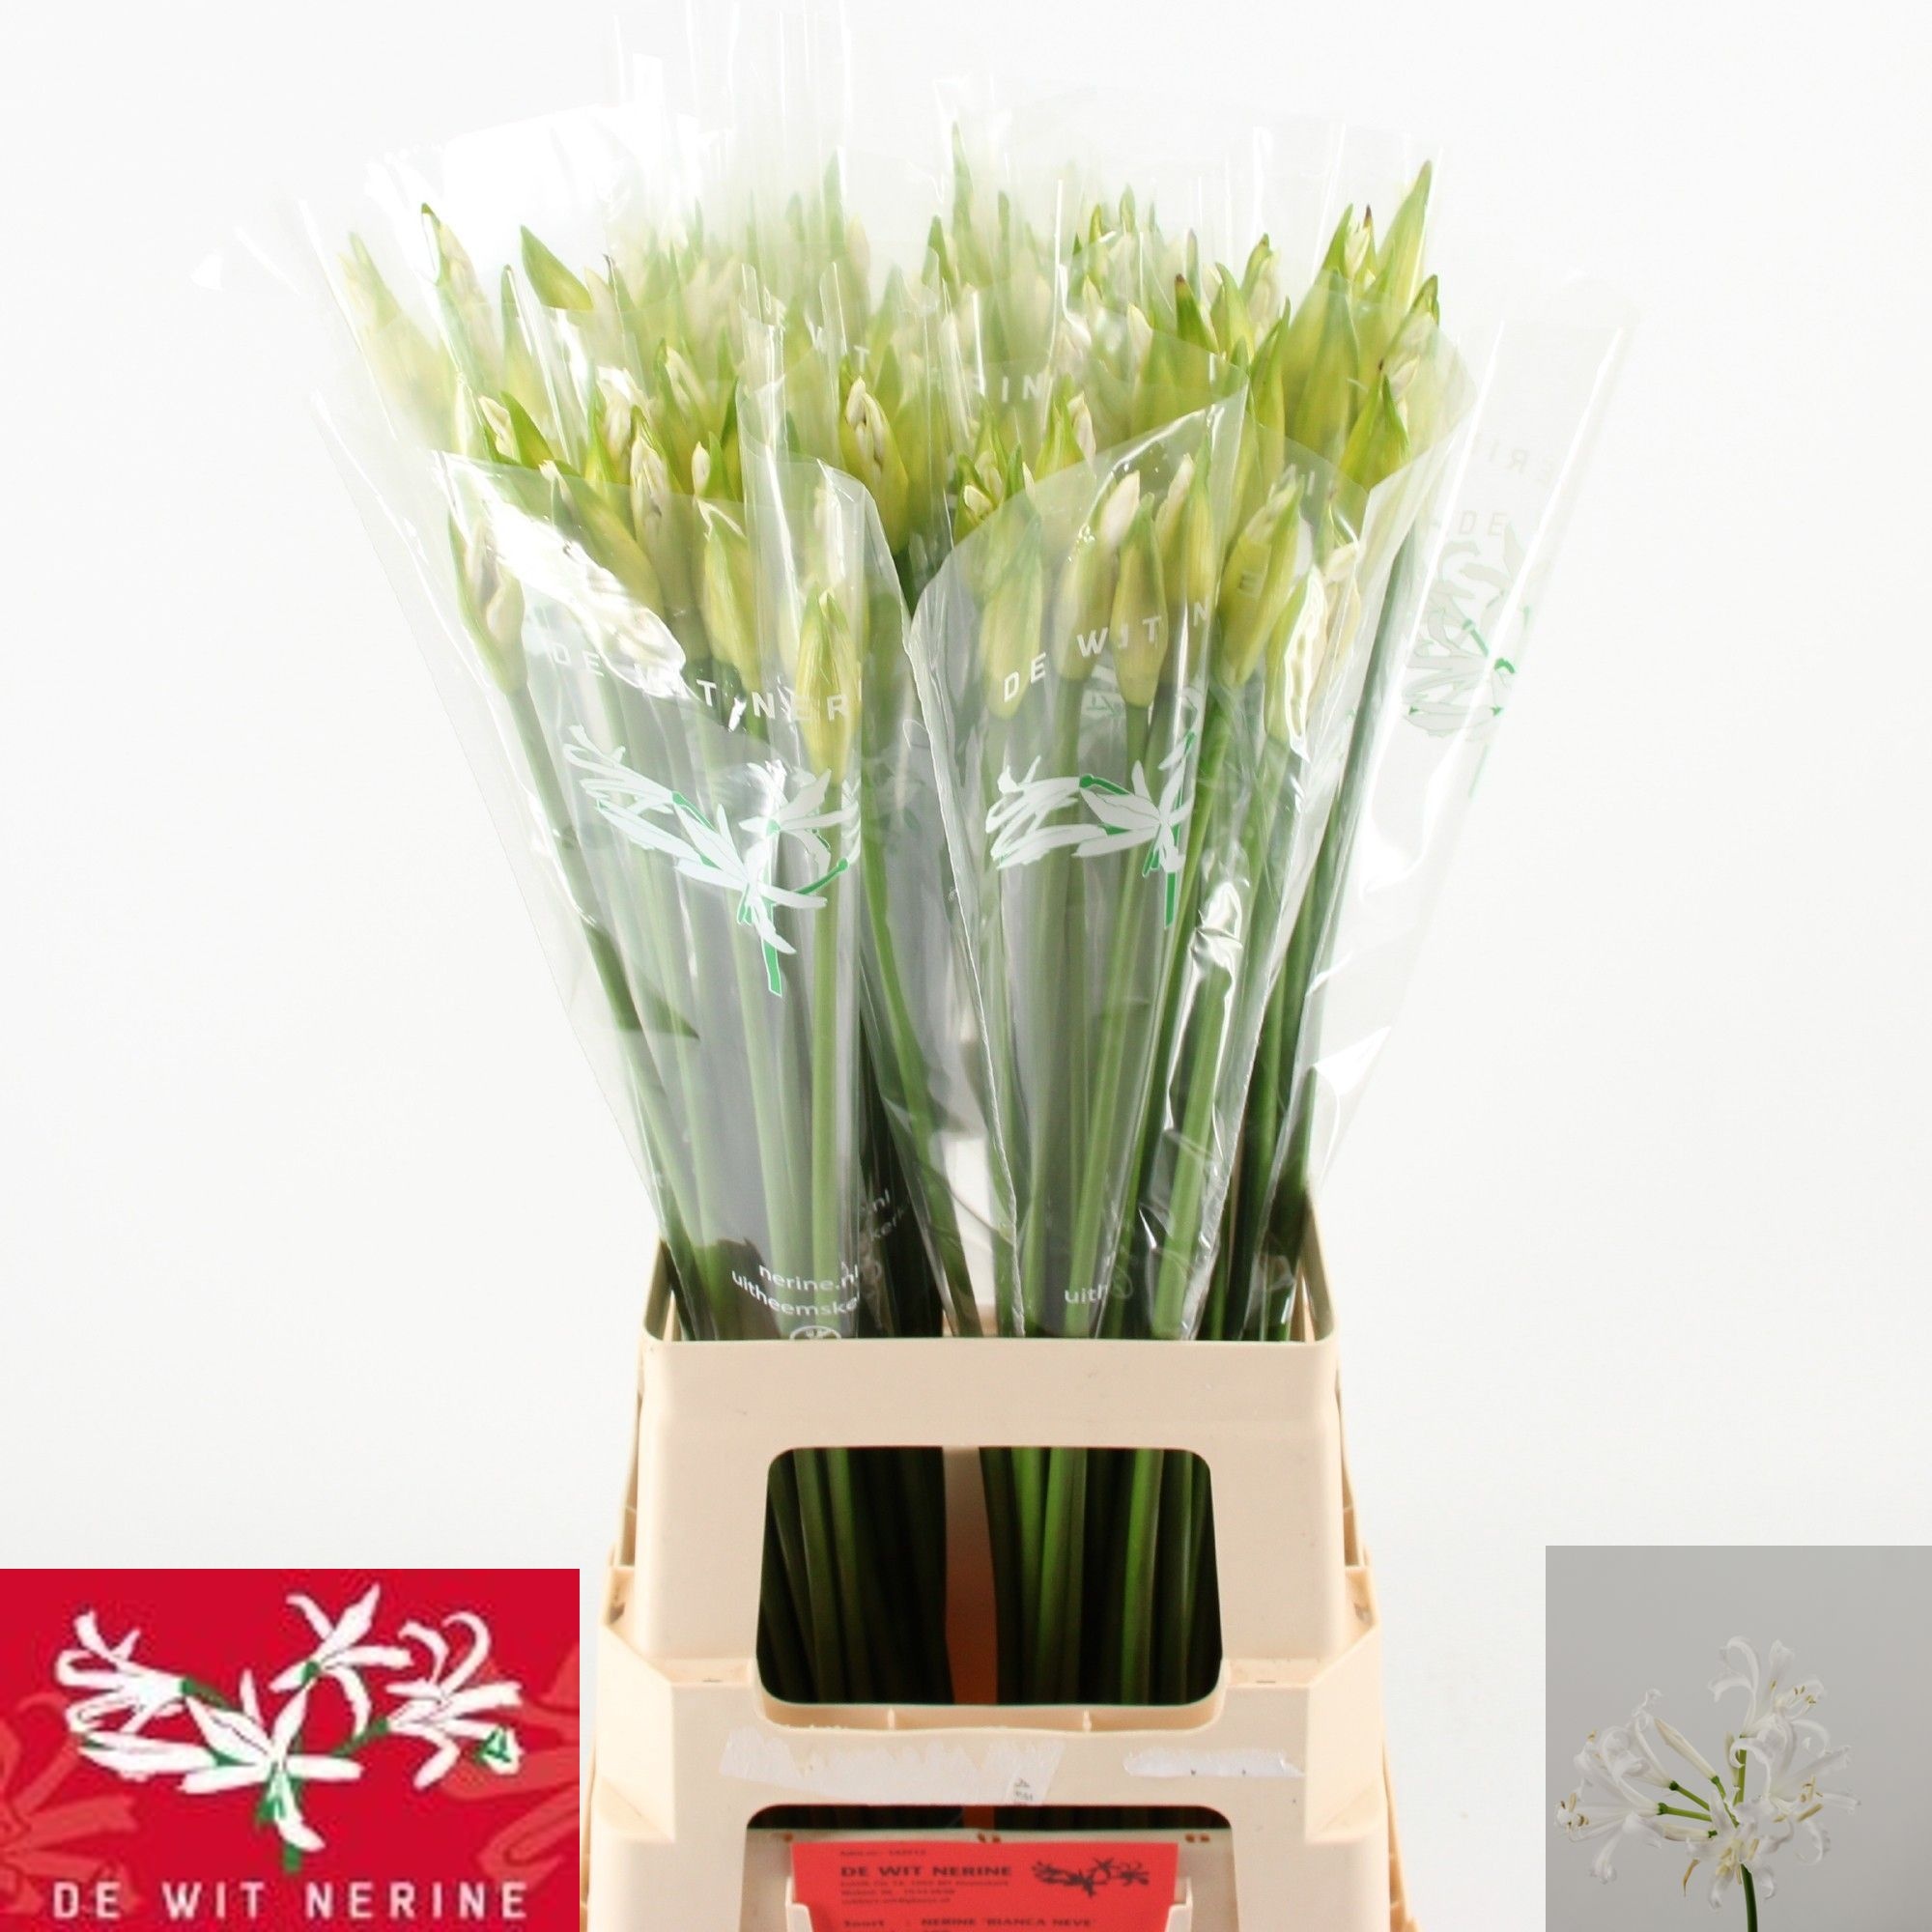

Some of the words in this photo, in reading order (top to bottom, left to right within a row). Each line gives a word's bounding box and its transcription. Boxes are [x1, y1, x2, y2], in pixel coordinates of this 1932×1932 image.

[550, 641, 605, 677] DE
[1004, 652, 1046, 702] DE
[1076, 614, 1162, 658] WIT
[758, 1264, 859, 1292] nerine.nl
[840, 1865, 867, 1877] DE
[879, 1865, 923, 1877] WIT
[932, 1865, 1011, 1877] NERINE
[921, 1918, 976, 1927] NERINE
